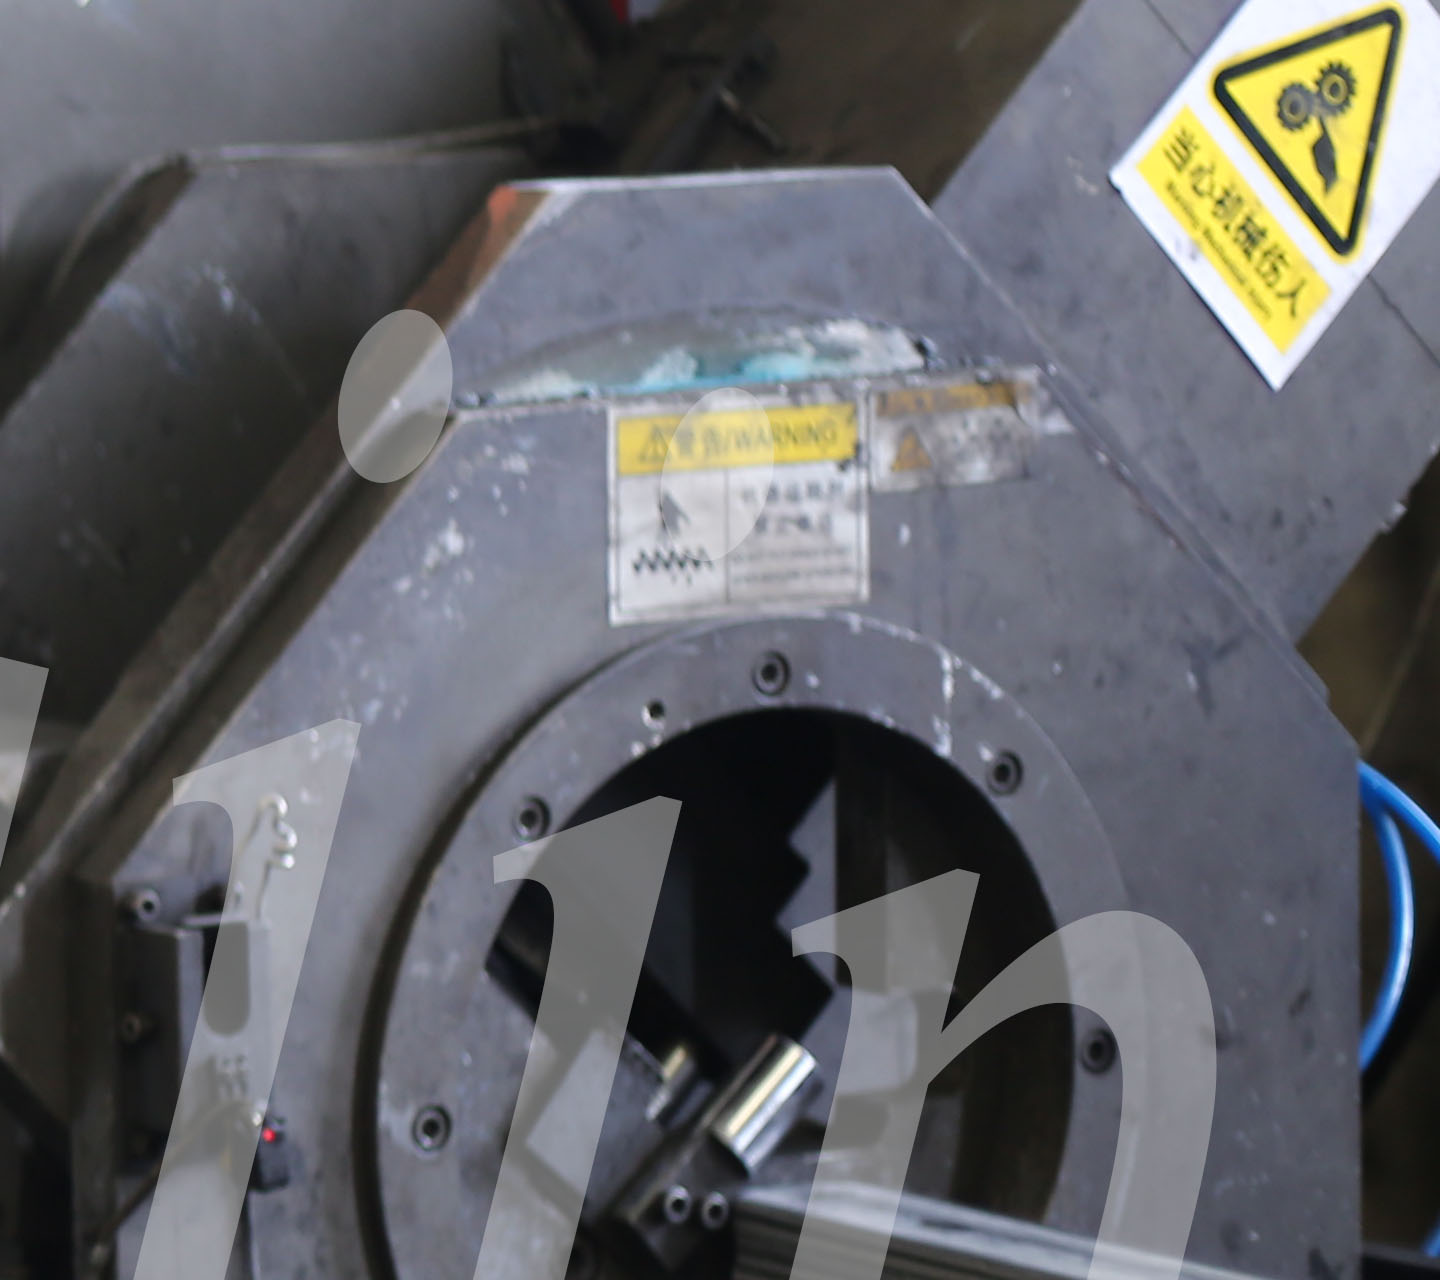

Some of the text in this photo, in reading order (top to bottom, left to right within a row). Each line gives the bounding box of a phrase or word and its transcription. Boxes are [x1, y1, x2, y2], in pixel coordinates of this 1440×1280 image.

[1164, 128, 1312, 319] 当心机械伤人
